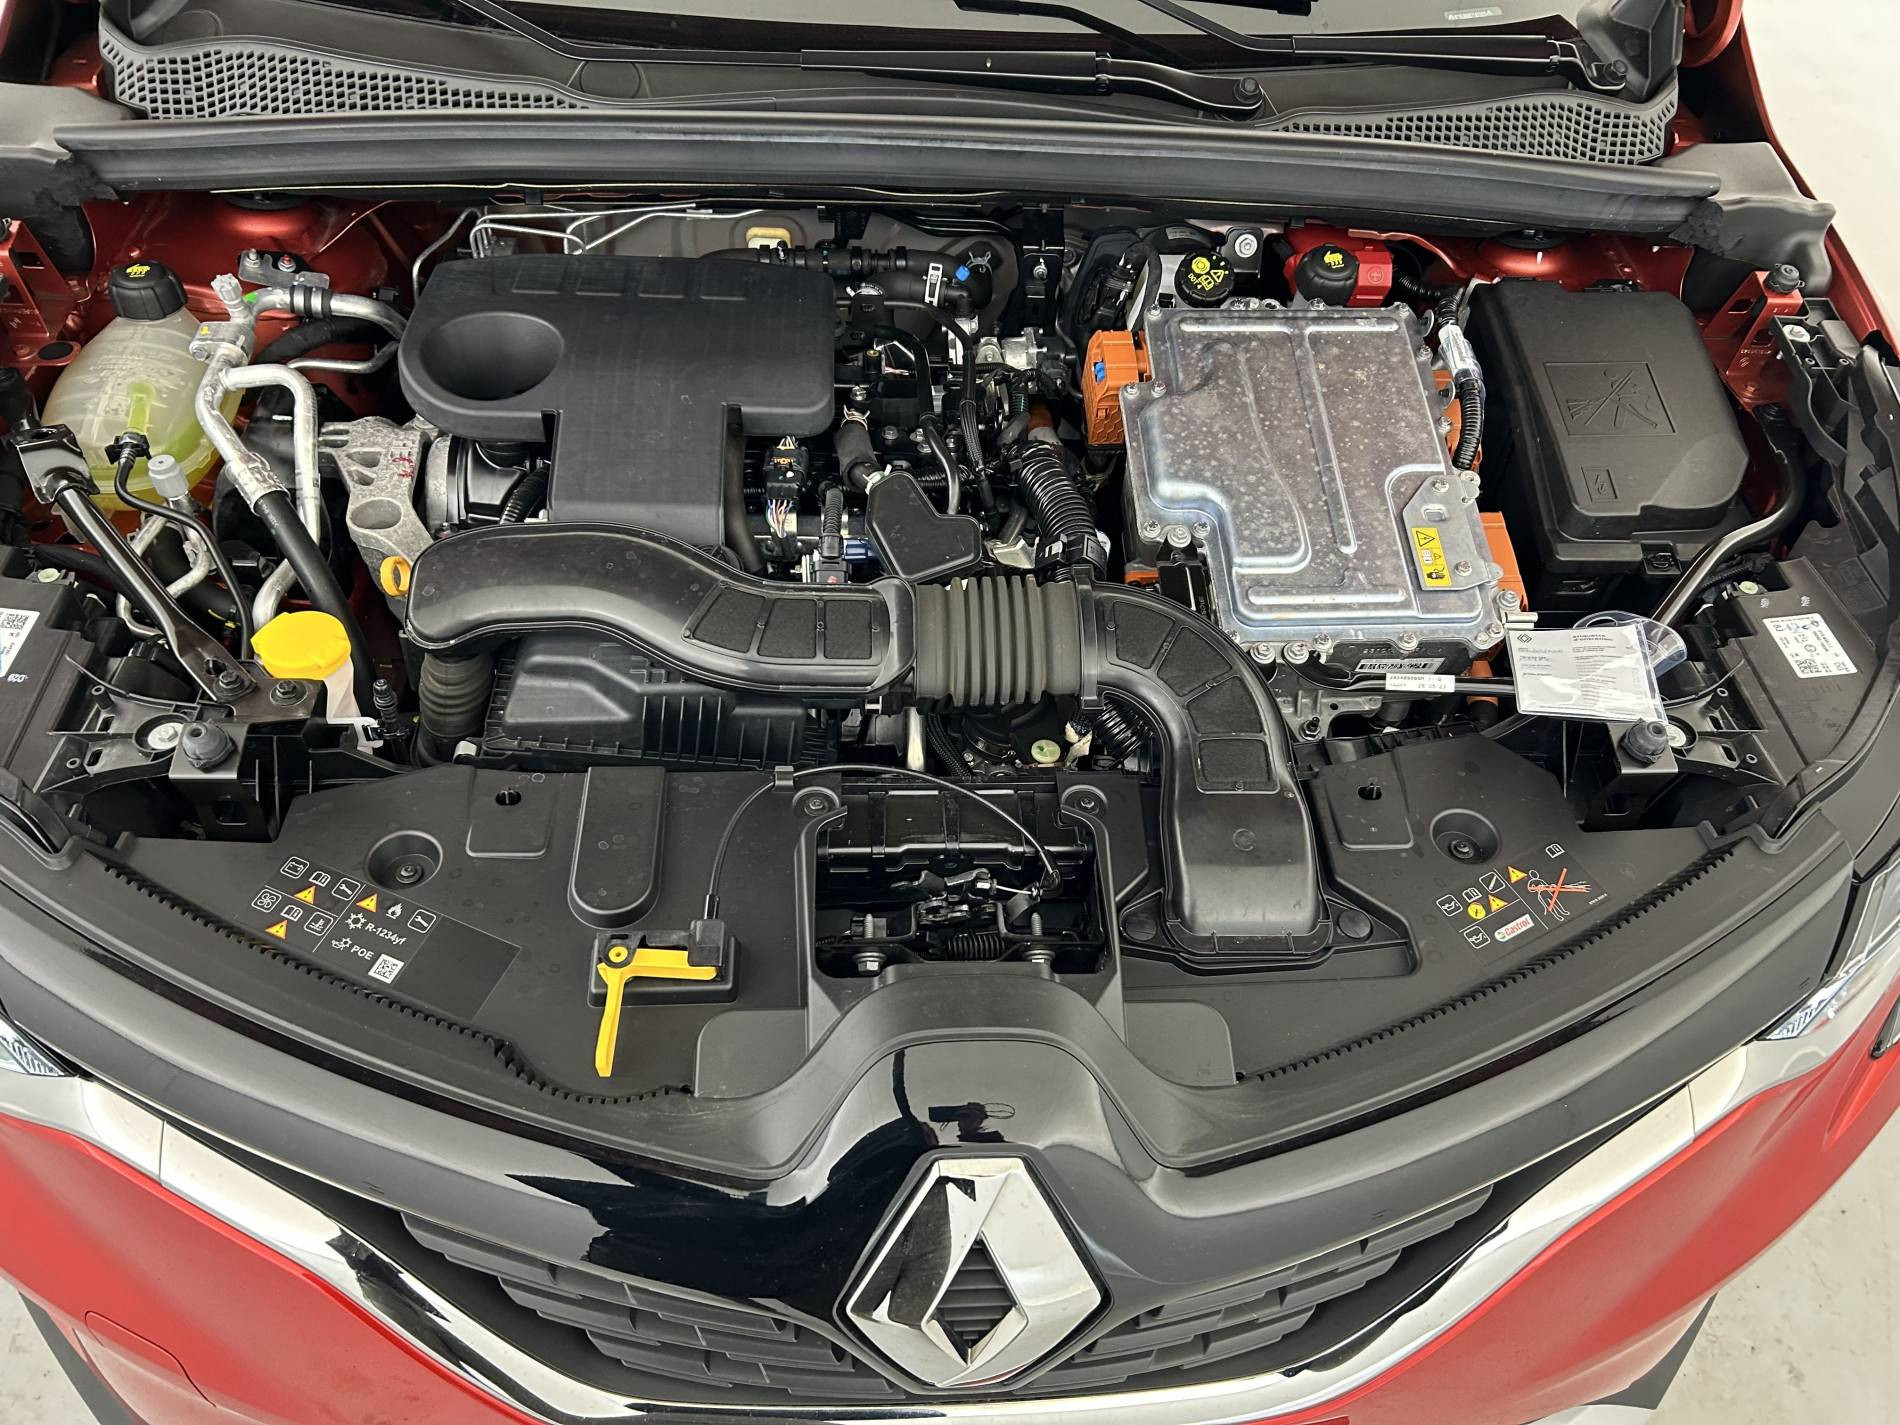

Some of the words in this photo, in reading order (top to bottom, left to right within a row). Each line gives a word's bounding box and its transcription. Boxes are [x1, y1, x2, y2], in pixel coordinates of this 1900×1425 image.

[1187, 272, 1200, 285] DOT
[364, 922, 407, 945] R-1234yf
[1504, 917, 1531, 937] Castrol
[350, 944, 375, 961] POE
